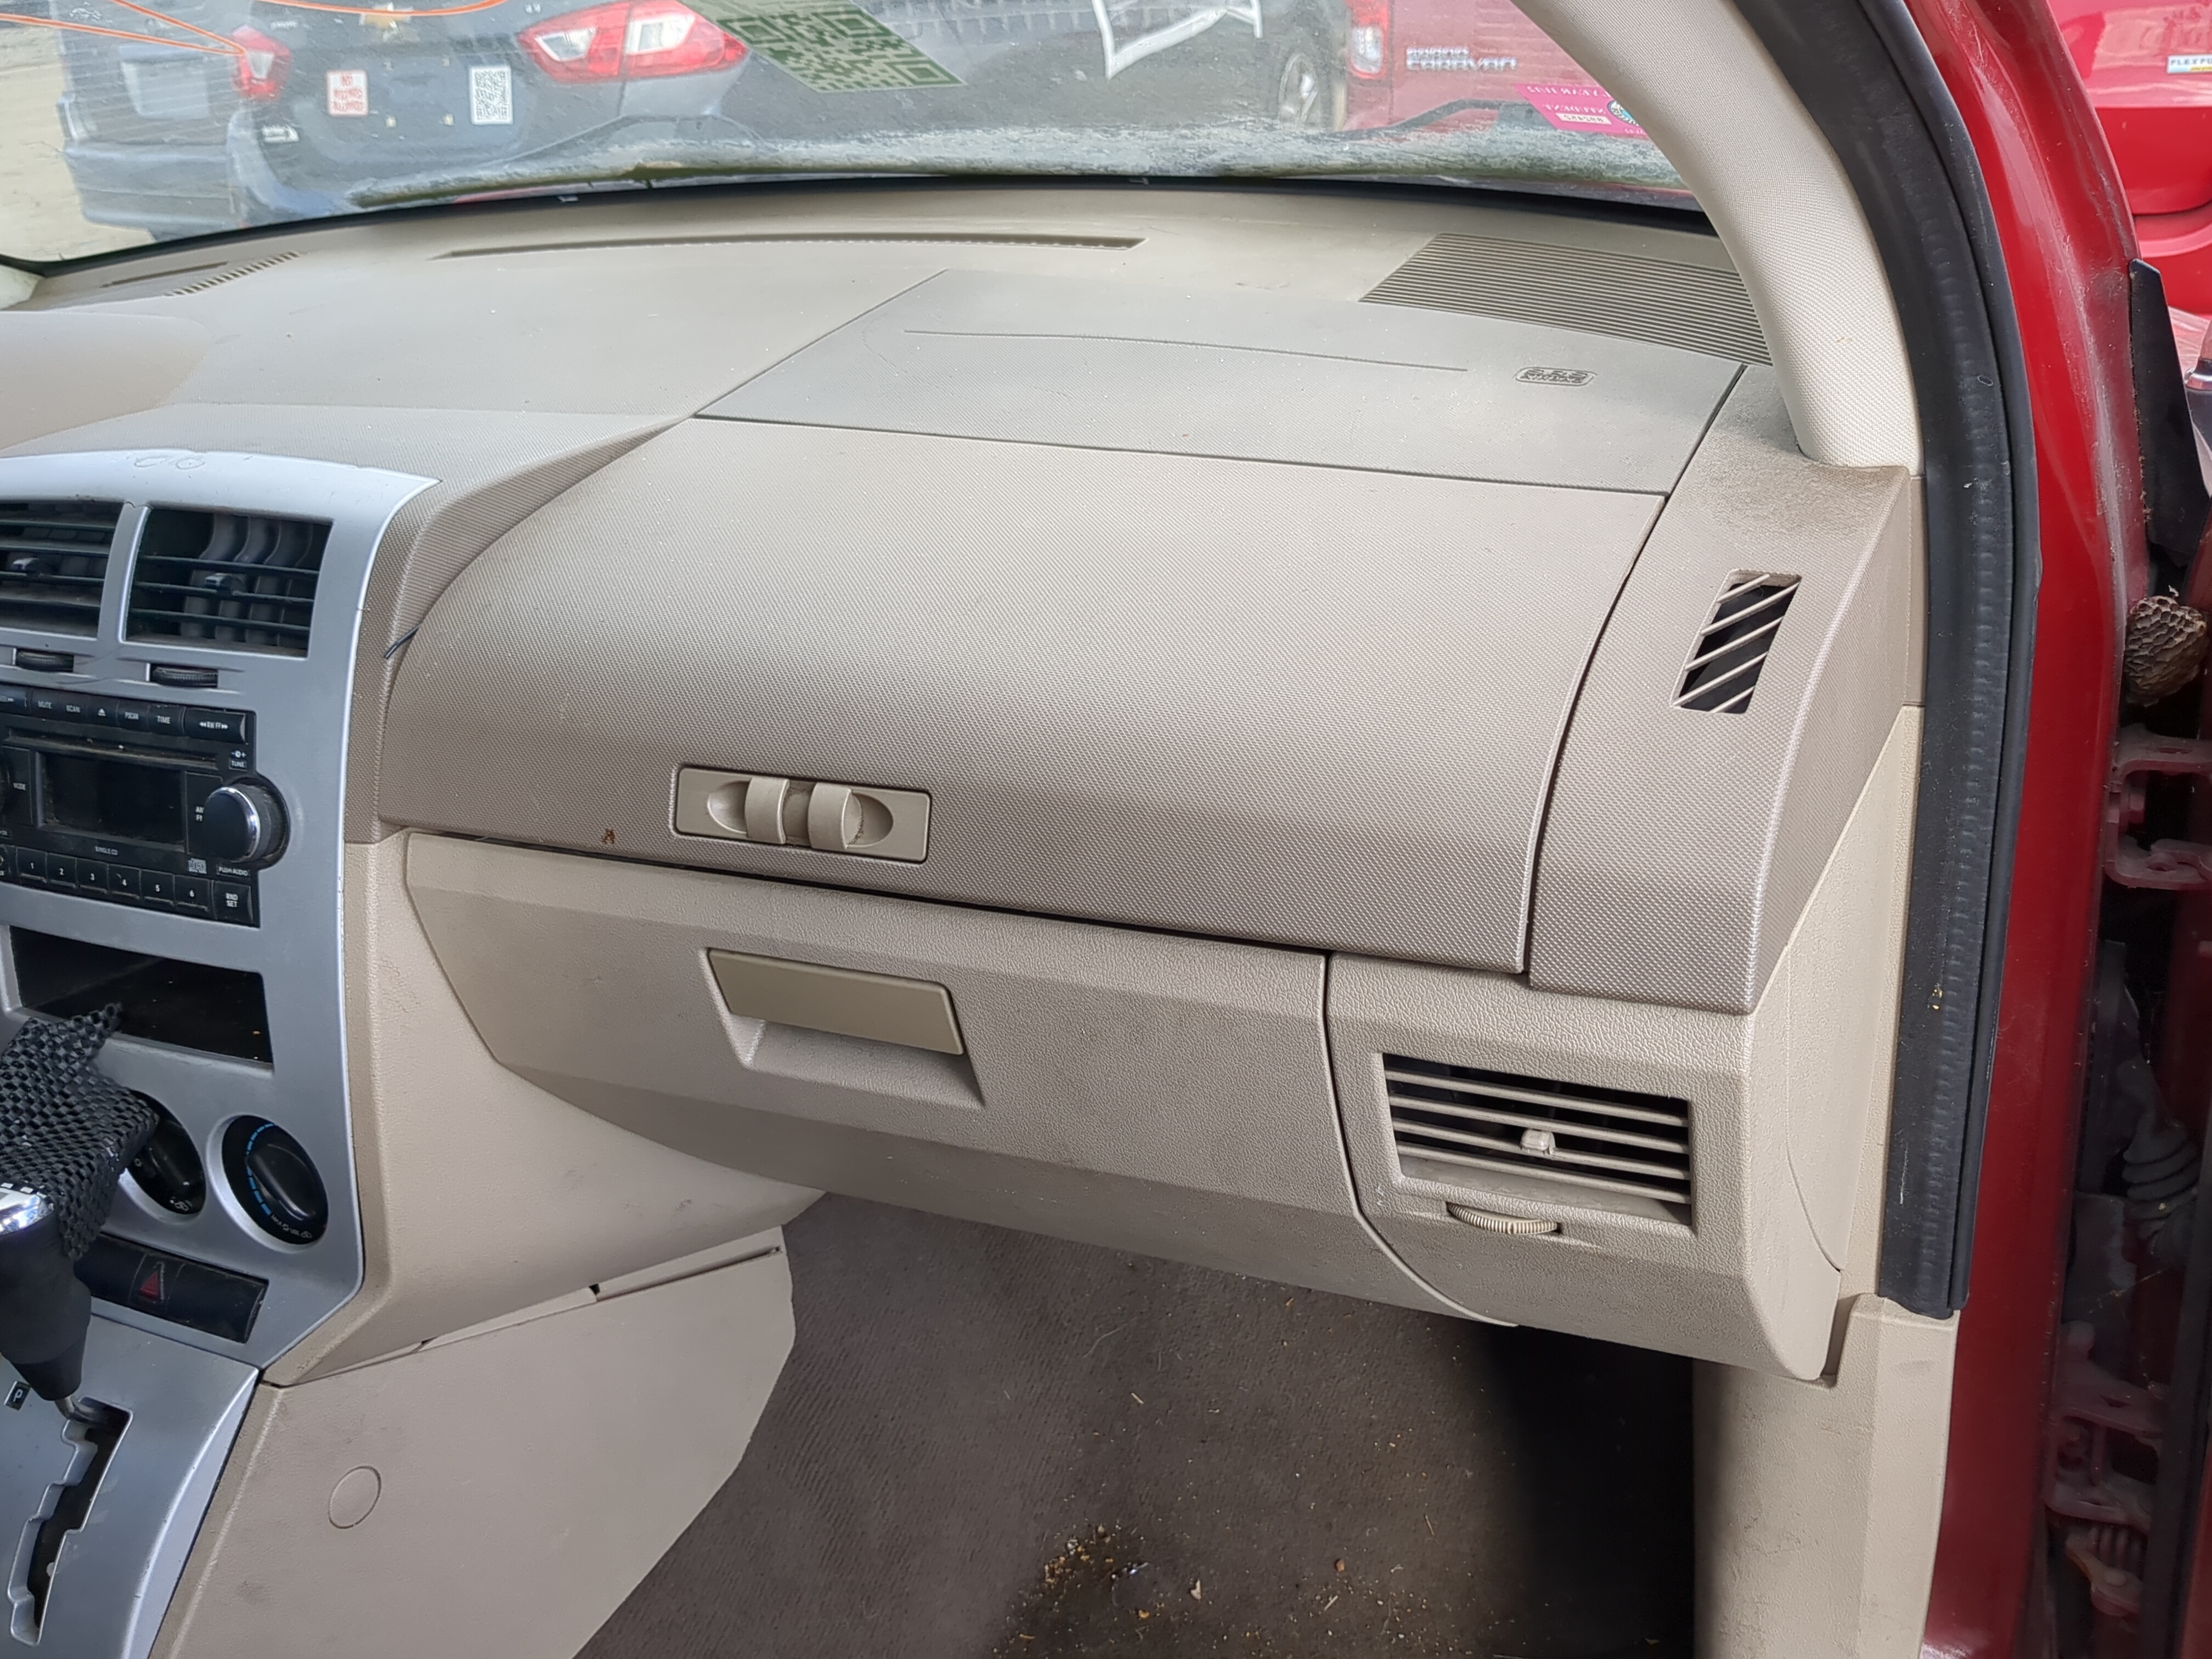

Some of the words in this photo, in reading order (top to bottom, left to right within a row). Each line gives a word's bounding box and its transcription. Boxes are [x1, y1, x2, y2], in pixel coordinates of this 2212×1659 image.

[1406, 57, 1517, 71] CARAVAN
[37, 701, 53, 709] MUTE
[66, 704, 81, 713] SCAN
[157, 715, 171, 724] TIME
[231, 760, 245, 768] TUNE
[13, 782, 26, 791] MODE
[94, 845, 111, 854] SINGLE
[59, 867, 64, 876] 2
[218, 866, 233, 874] PUSH
[232, 868, 249, 876] AUDIO
[90, 873, 95, 881] 3
[155, 884, 160, 892] 5
[189, 889, 195, 898] 6
[225, 892, 238, 901] RND
[226, 900, 238, 908] SET
[13, 1389, 23, 1402] P
